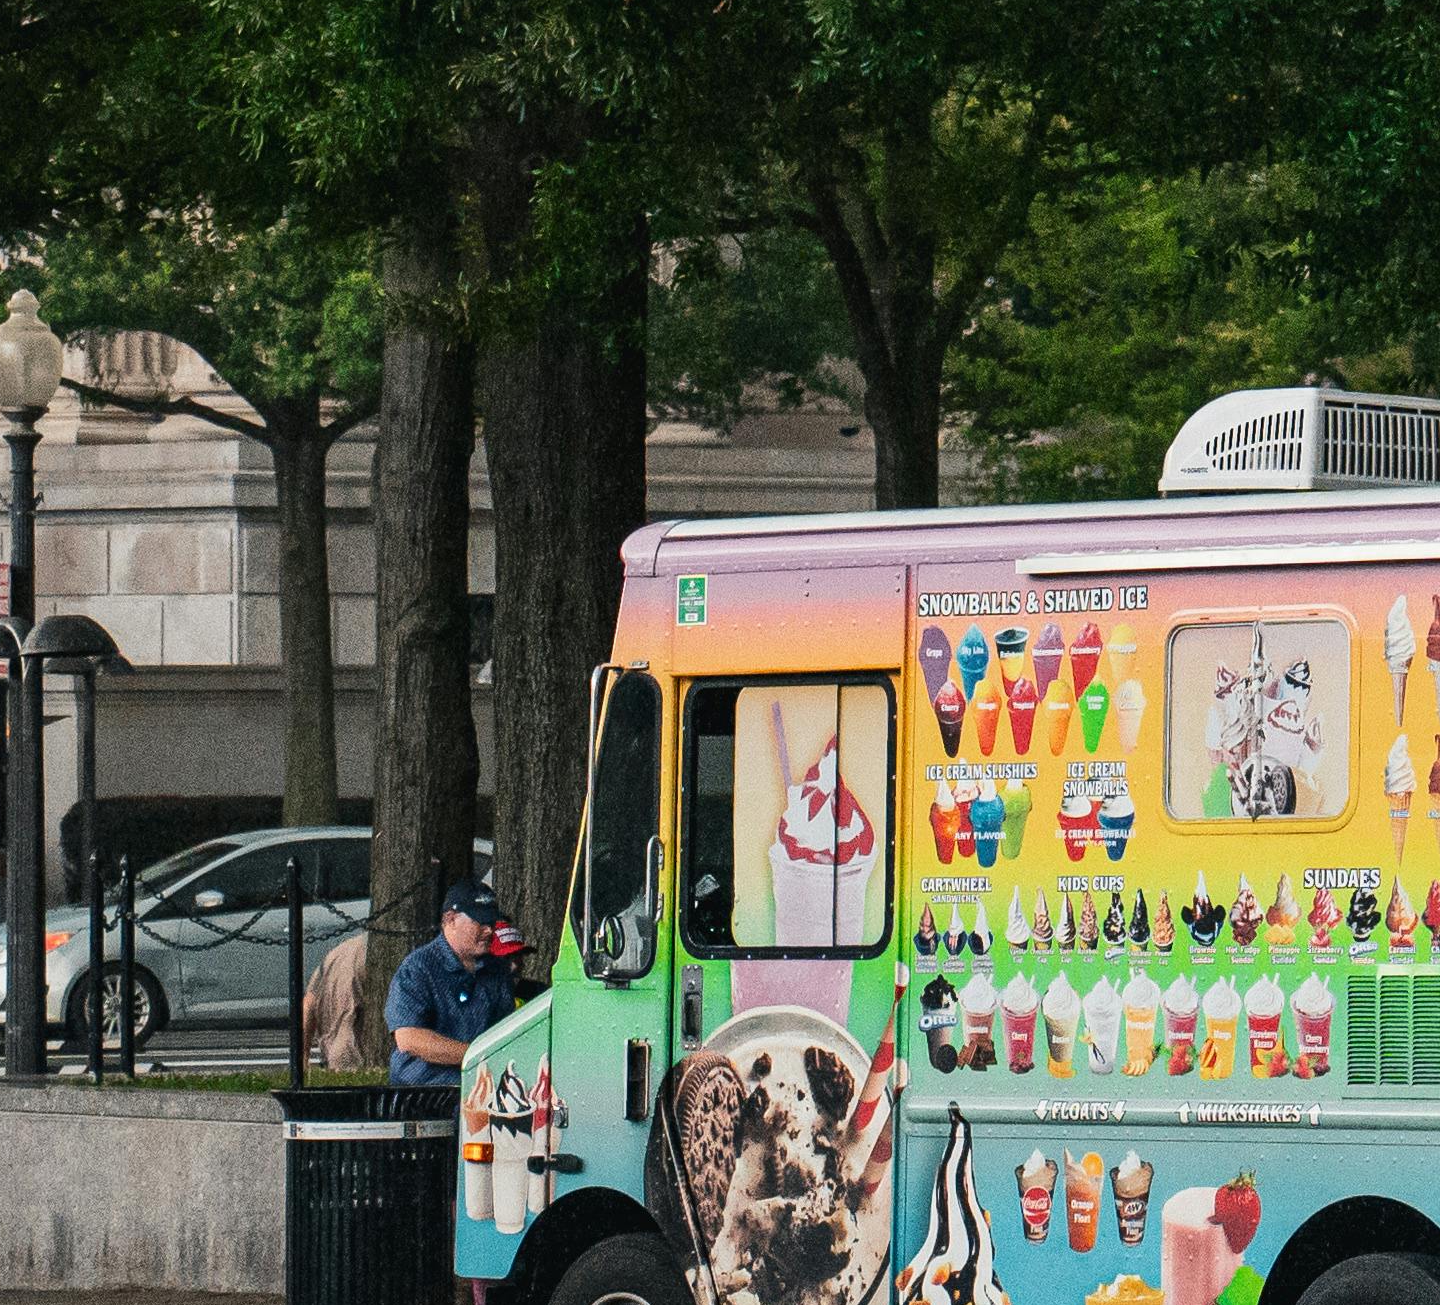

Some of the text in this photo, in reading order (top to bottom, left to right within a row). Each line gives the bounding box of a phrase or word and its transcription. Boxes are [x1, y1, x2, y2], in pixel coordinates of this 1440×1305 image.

[918, 585, 1148, 617] SNOWBALLS & SHAVED ICE
[926, 648, 943, 659] Grape
[926, 762, 1038, 781] ICE CREAM SLUSHIES
[1066, 761, 1127, 778] ICE CREAM
[1063, 780, 1129, 797] SNOWBALLS
[954, 831, 1007, 840] ANY FLAVOR
[1068, 829, 1093, 839] CREAM
[1057, 876, 1125, 892] KIDS CUPS
[1303, 867, 1381, 890] SUNDAES
[920, 877, 993, 893] CARTWHEEL
[931, 894, 982, 904] SANDWICHES
[1189, 946, 1217, 955] Brownie
[1241, 946, 1261, 956] Fudge
[1268, 945, 1301, 956] Pineapple
[1307, 946, 1344, 956] Strawberry
[1389, 945, 1416, 954] Caramel
[920, 1014, 957, 1029] OREO
[1011, 1031, 1028, 1042] Cherry
[1050, 1102, 1110, 1122] FLOATS
[1196, 1102, 1303, 1124] MILKSHAKES
[1071, 1199, 1094, 1212] Orange
[1074, 1213, 1091, 1224] Float
